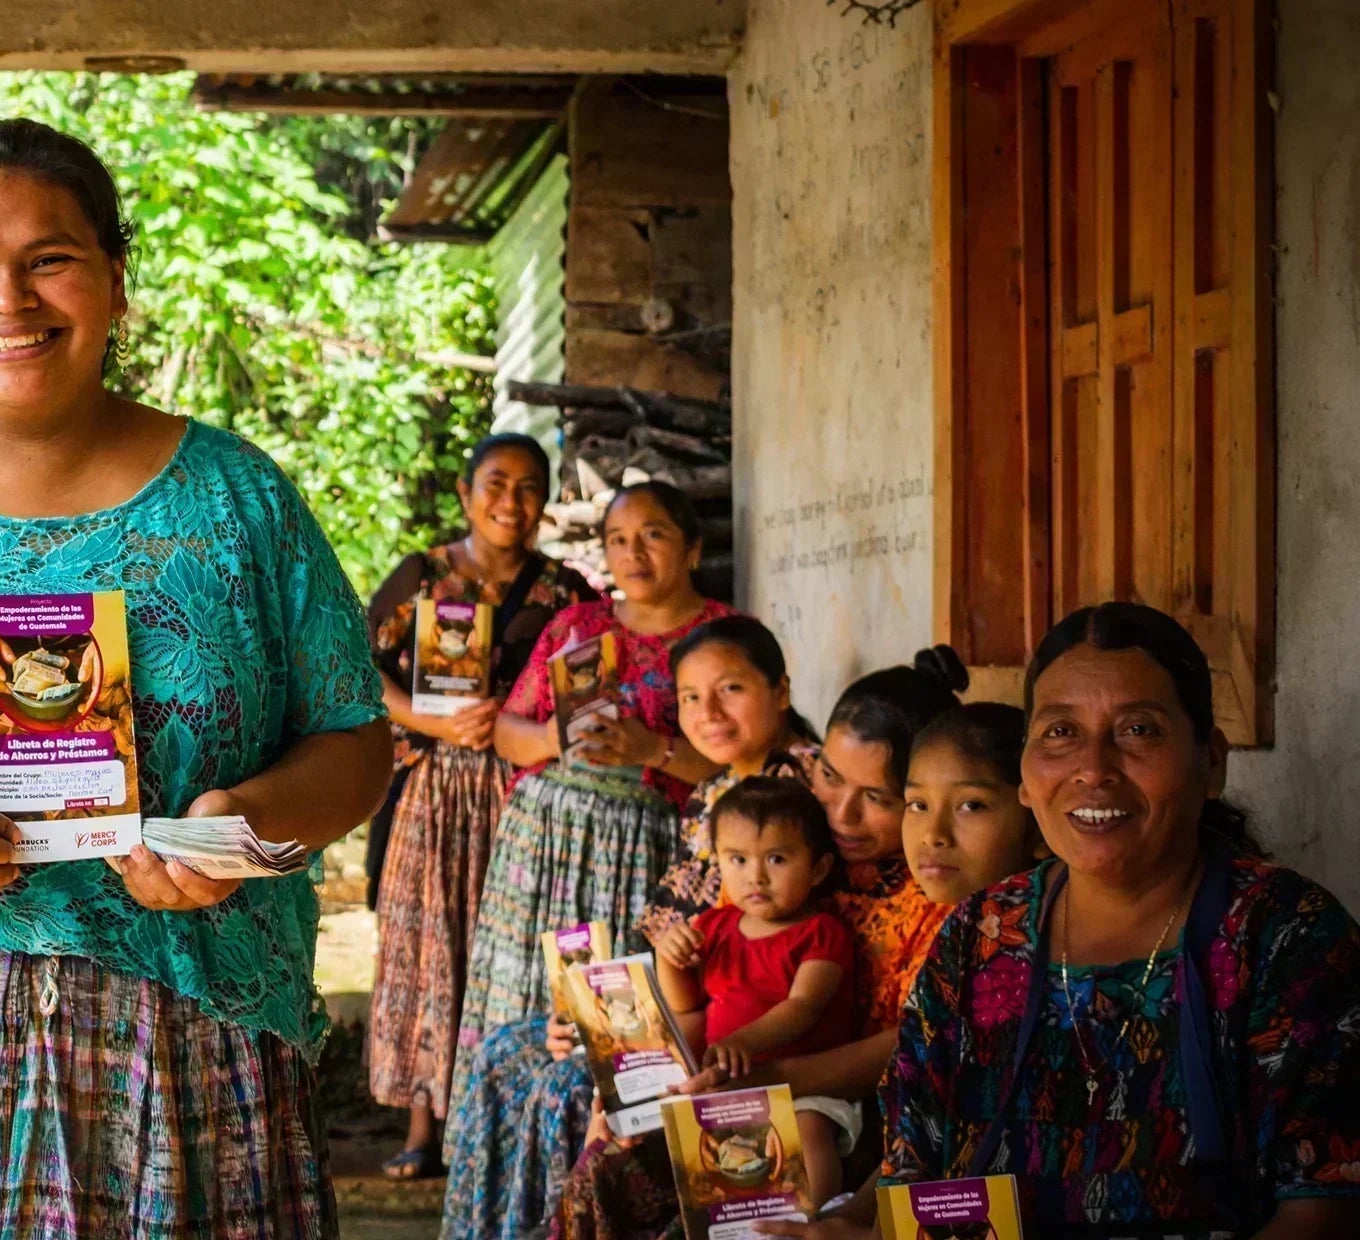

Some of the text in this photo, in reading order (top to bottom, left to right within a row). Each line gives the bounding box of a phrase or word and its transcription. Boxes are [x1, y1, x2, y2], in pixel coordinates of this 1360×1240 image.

[0, 605, 60, 614] Empoderamiento
[36, 613, 85, 621] Comunidades
[18, 622, 67, 630] de Guatemala
[7, 737, 97, 750] Libreta de Registro
[10, 750, 49, 761] Ahorros
[49, 751, 57, 761] y
[58, 748, 108, 759] Préstamos
[90, 830, 117, 839] MERCY
[91, 839, 117, 847] CORPS
